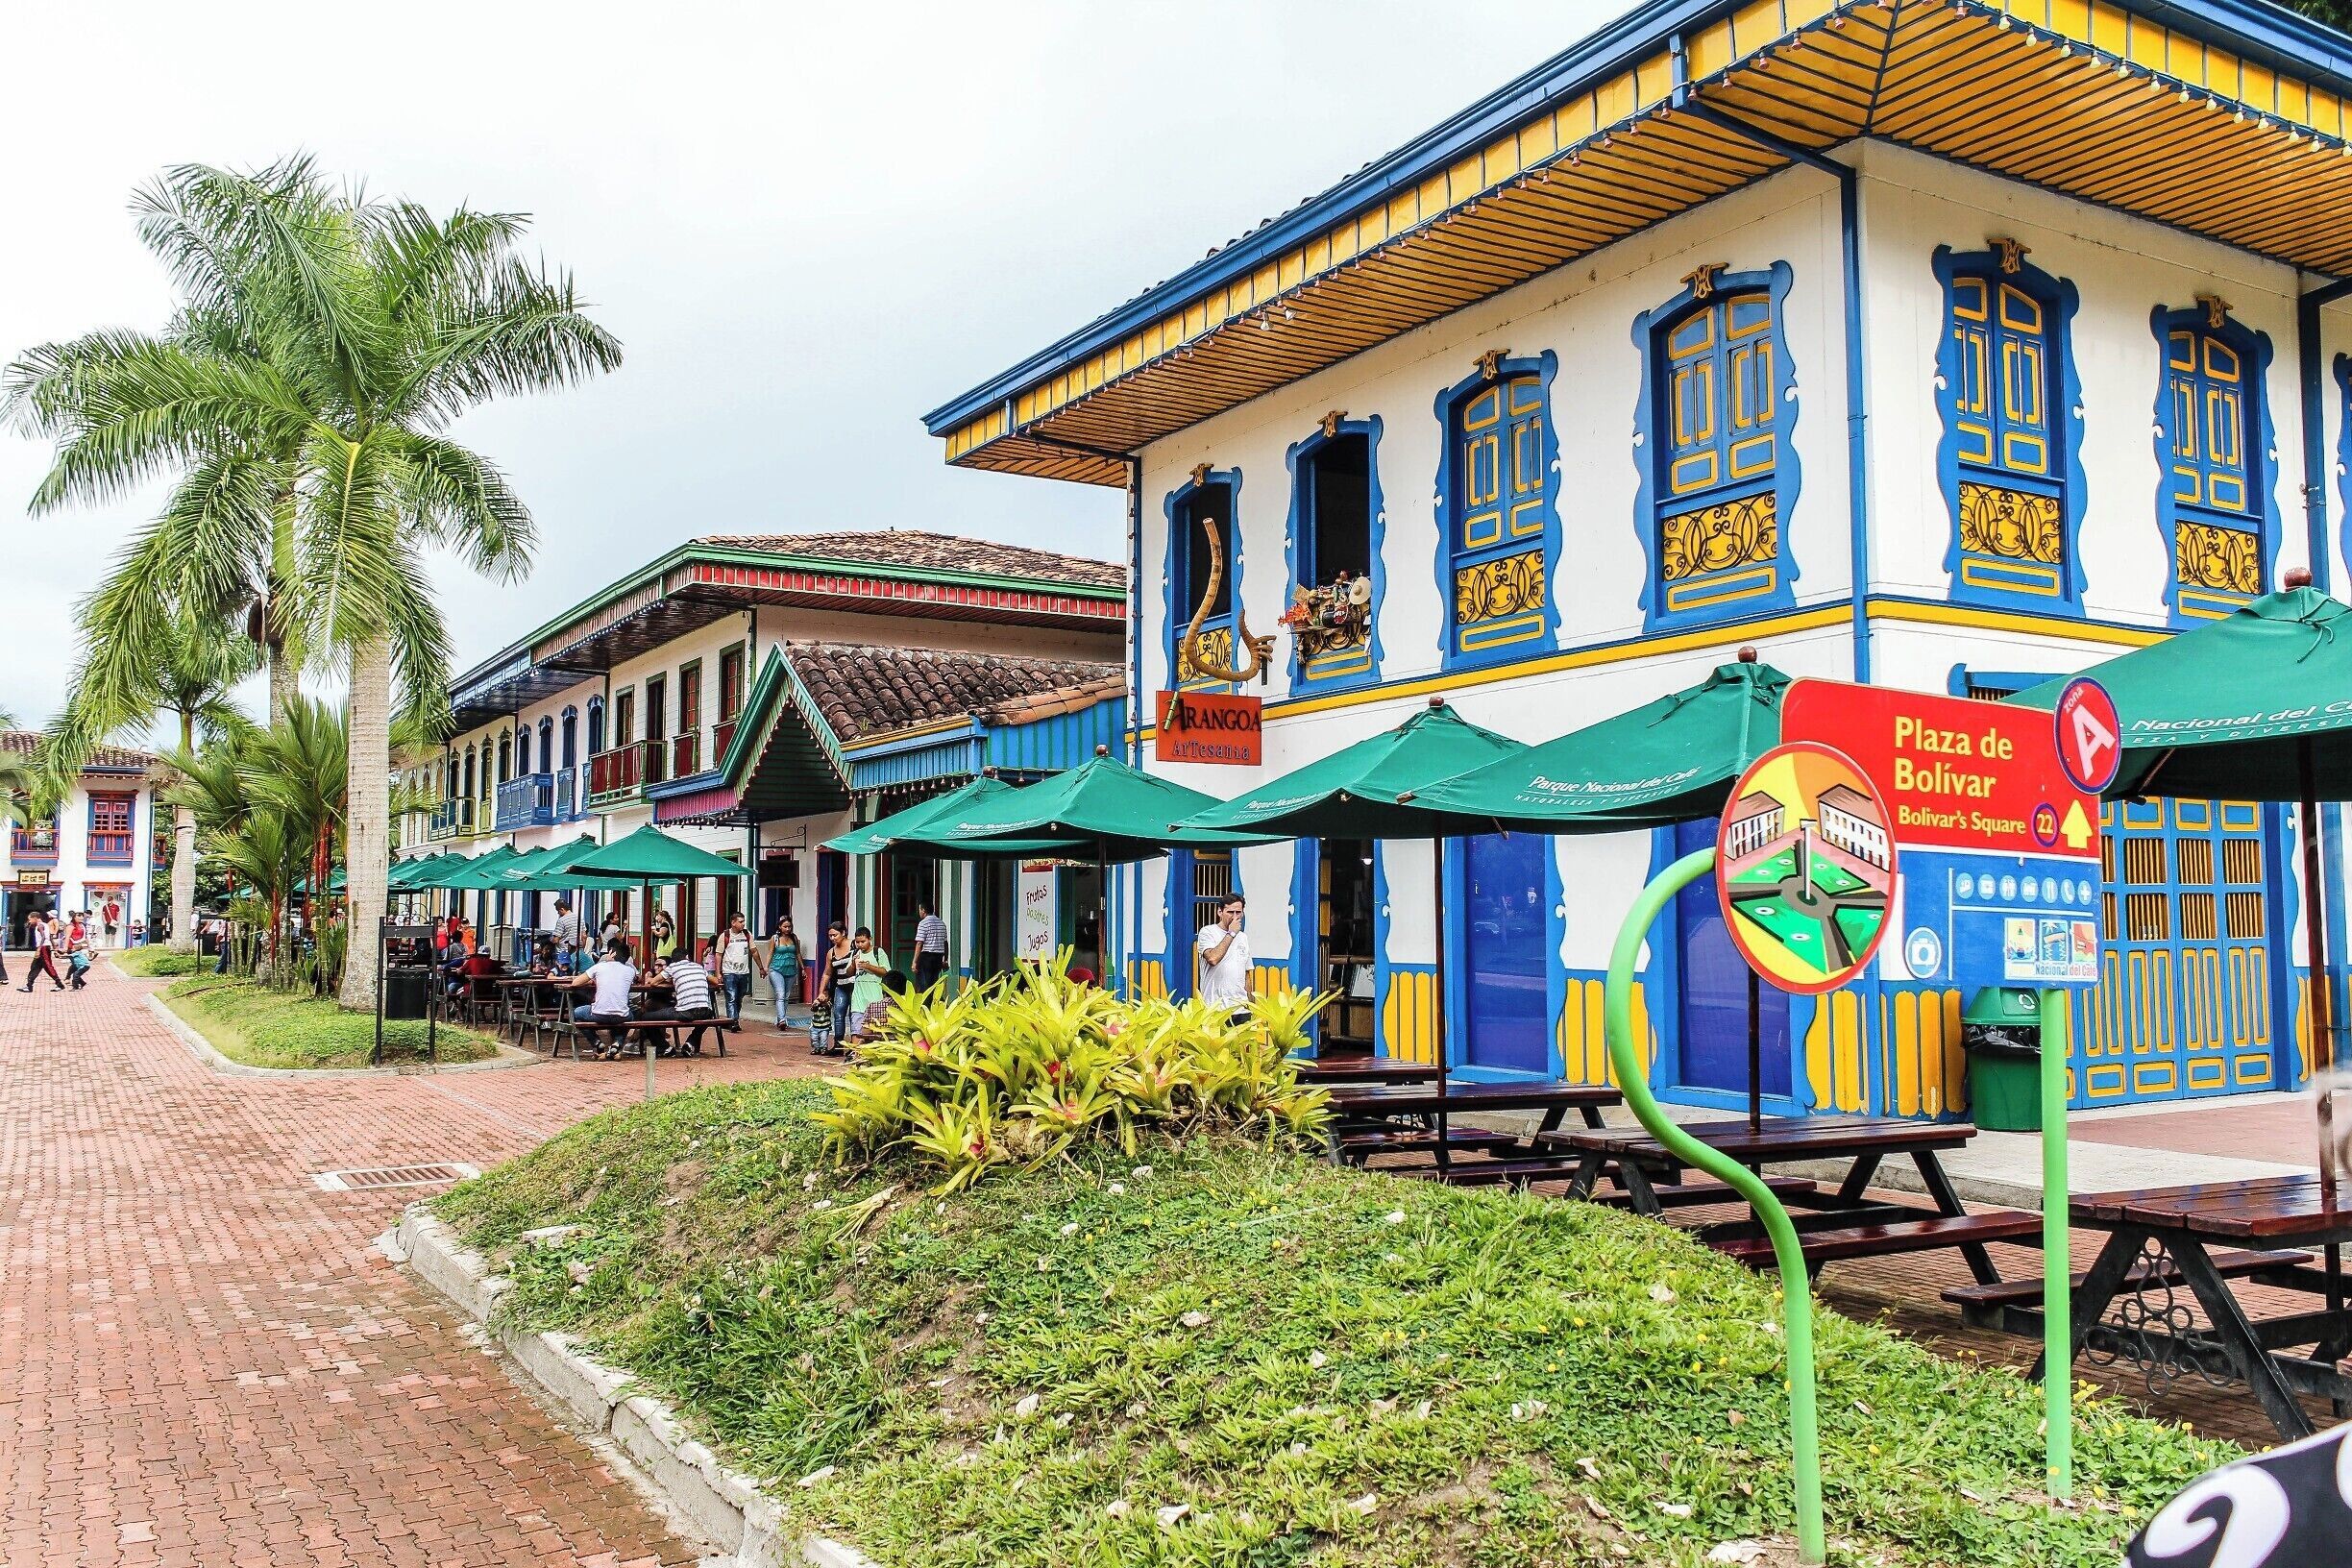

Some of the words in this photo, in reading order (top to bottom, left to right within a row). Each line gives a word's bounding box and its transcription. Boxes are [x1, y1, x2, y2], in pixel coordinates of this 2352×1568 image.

[2063, 686, 2085, 714] zona
[2129, 712, 2264, 731] Nacional
[2267, 705, 2317, 722] del
[1895, 715, 1972, 756] Plaza
[1979, 727, 2014, 760] de
[2072, 703, 2117, 781] A
[1528, 775, 1580, 794] Parque
[1579, 779, 1647, 793] Nacional
[1641, 774, 1670, 789] del
[1895, 757, 1997, 798] Bolívar
[1899, 804, 1968, 829] Bolivar's
[1971, 811, 2026, 837] Square
[2036, 813, 2054, 834] 22
[1027, 930, 1049, 952] Jugos
[2035, 964, 2069, 976] Nacional
